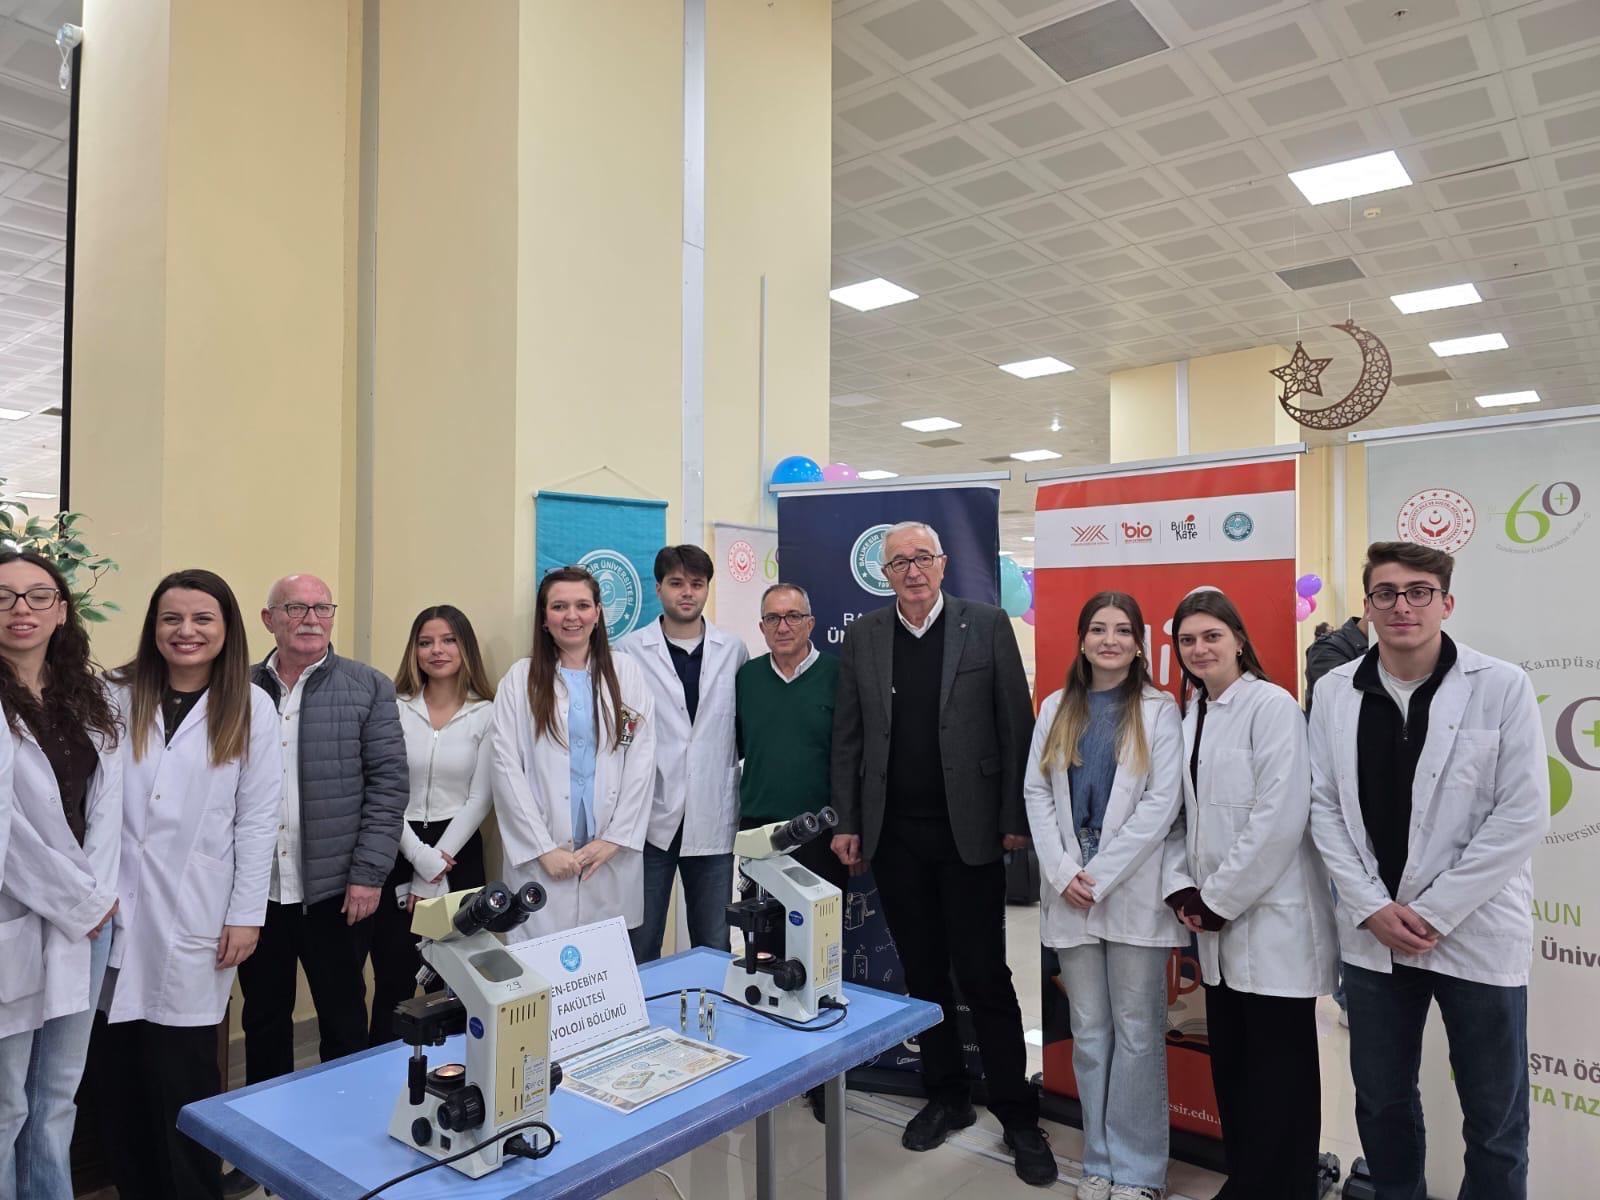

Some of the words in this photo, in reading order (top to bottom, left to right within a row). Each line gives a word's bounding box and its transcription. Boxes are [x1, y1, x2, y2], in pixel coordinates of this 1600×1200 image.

[1544, 821, 1600, 845] niversite
[551, 970, 608, 998] EN-EDEBİYAT
[557, 988, 606, 1016] FAKÜLTESİ
[586, 1002, 627, 1028] BÖLÜMÜ
